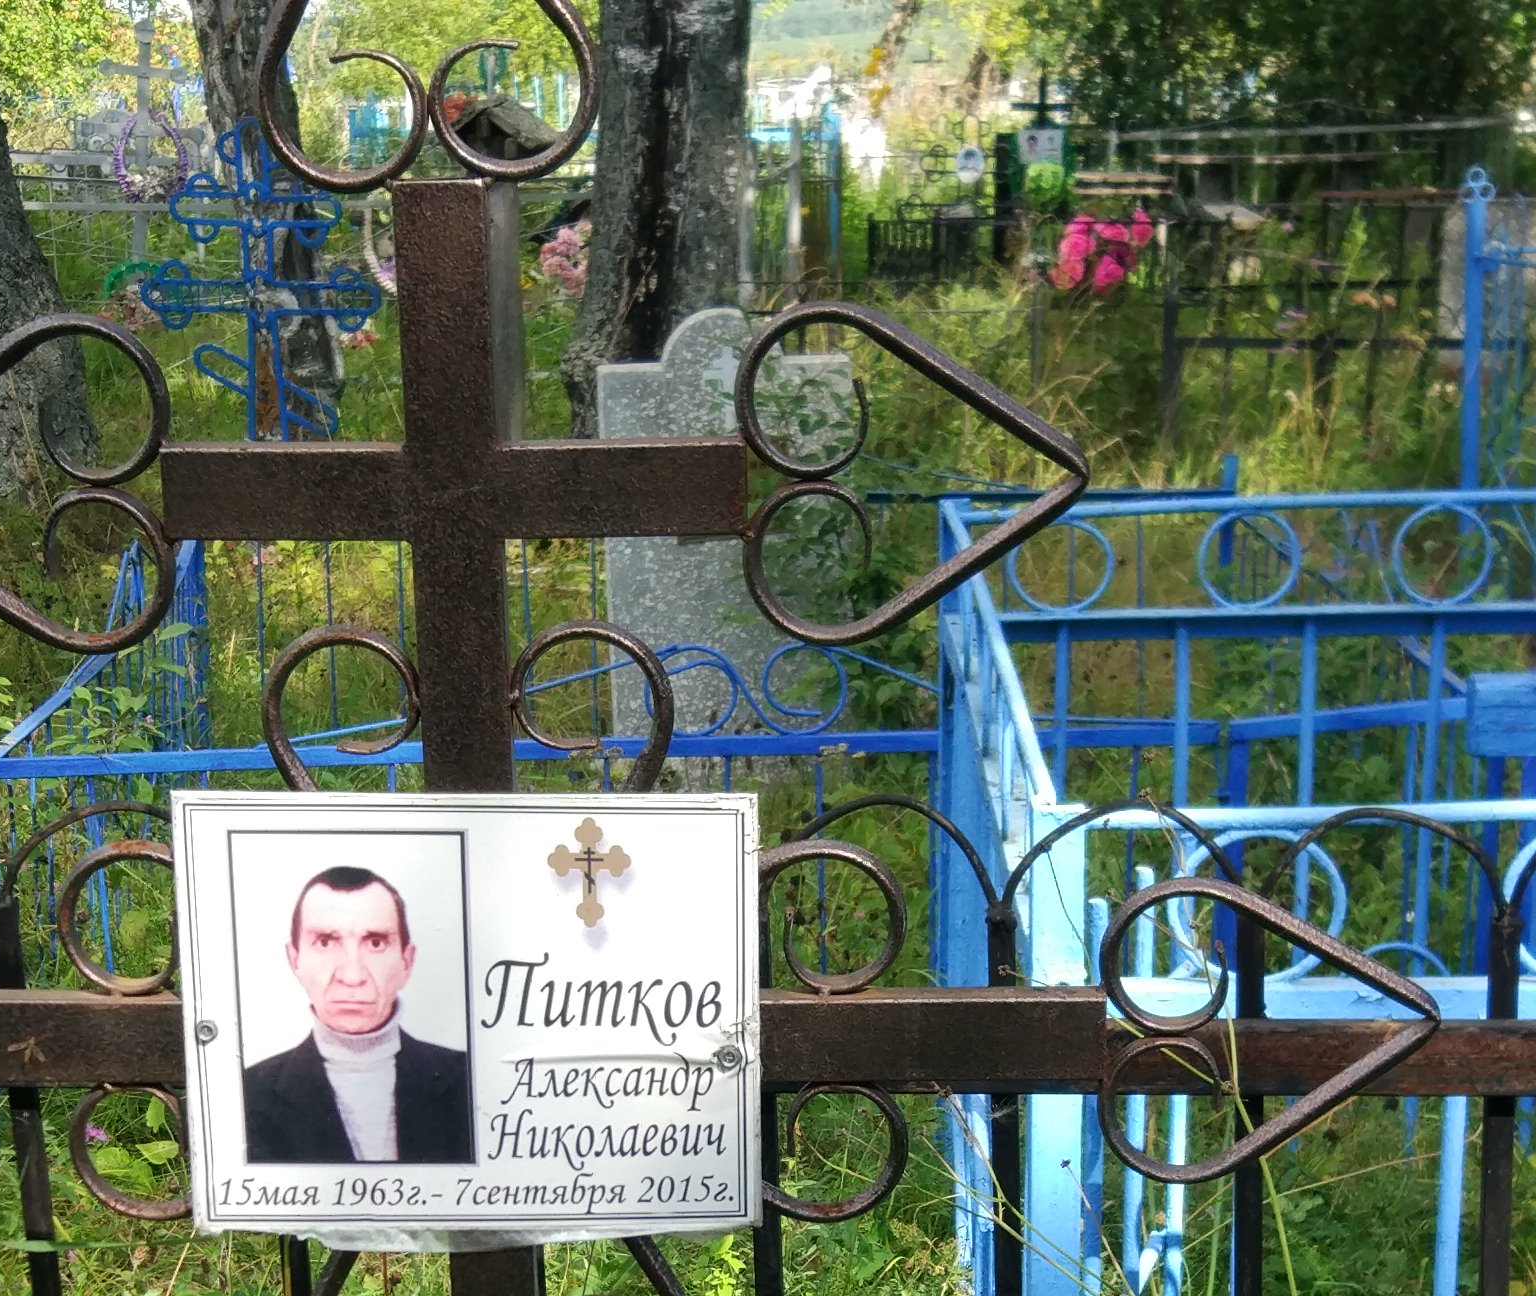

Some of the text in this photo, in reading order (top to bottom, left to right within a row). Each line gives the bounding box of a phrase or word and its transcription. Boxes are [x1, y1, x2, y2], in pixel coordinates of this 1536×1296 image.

[481, 952, 722, 1047] Питков
[501, 1052, 714, 1111] Александр
[488, 1109, 726, 1171] Николаевич
[637, 1174, 735, 1204] 2015г.
